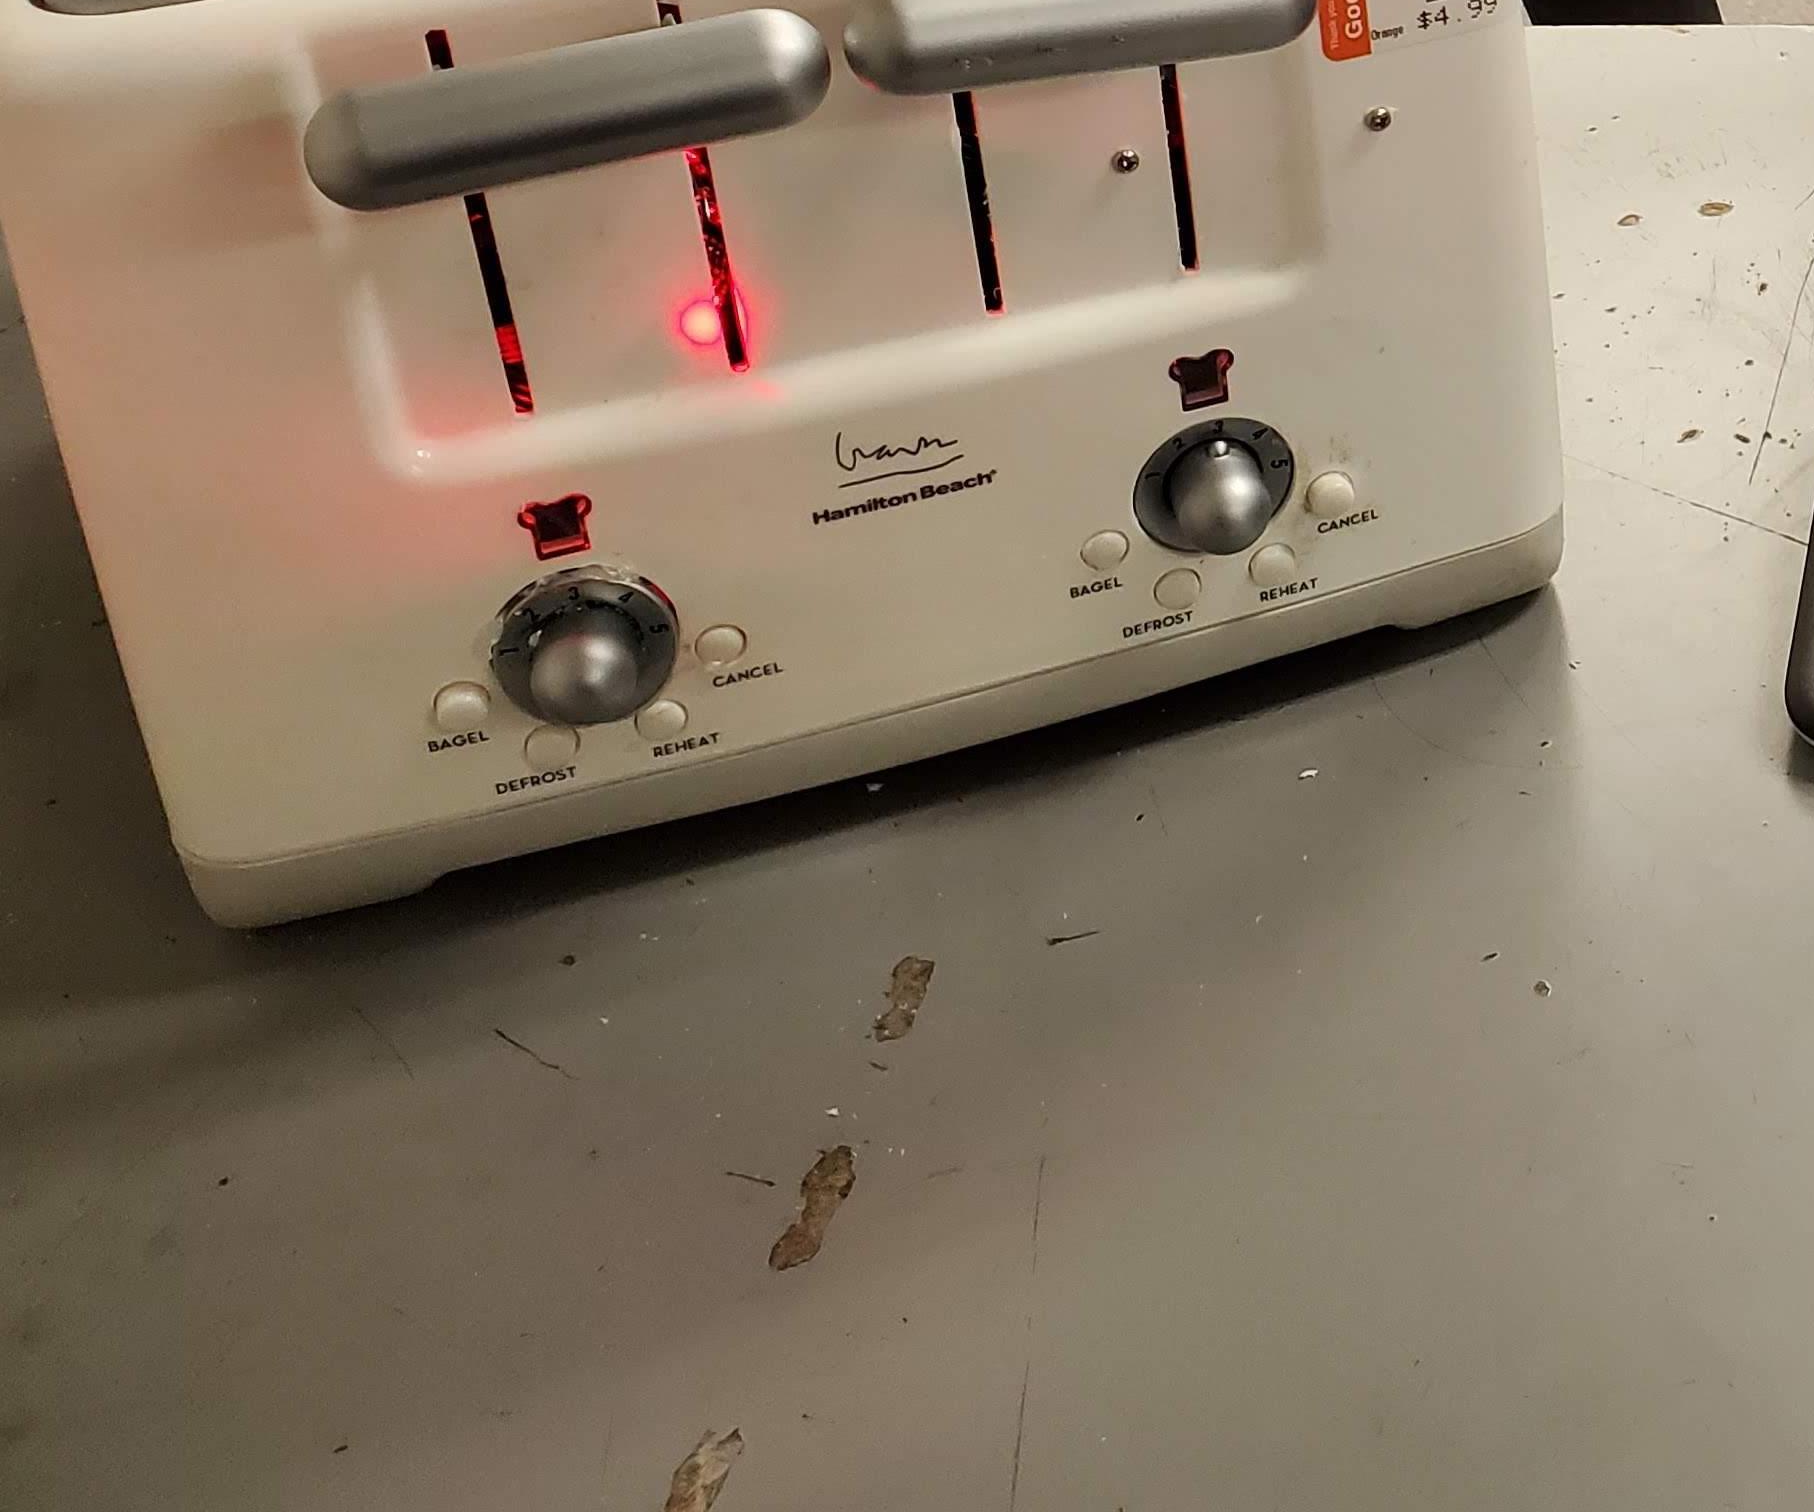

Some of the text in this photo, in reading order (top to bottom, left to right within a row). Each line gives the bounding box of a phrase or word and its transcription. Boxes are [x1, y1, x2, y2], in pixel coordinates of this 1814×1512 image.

[1371, 26, 1404, 40] Orange
[812, 472, 992, 525] Hamilton Beach
[1317, 509, 1379, 534] CANCEL
[1070, 576, 1124, 599] BAGEL
[1259, 577, 1318, 602] REHEAT
[1122, 611, 1193, 638] DEFROST
[712, 662, 784, 688] CANCEL
[428, 730, 490, 753] BAGEL
[653, 732, 720, 758] REHEAT
[495, 766, 577, 795] DEFROST
